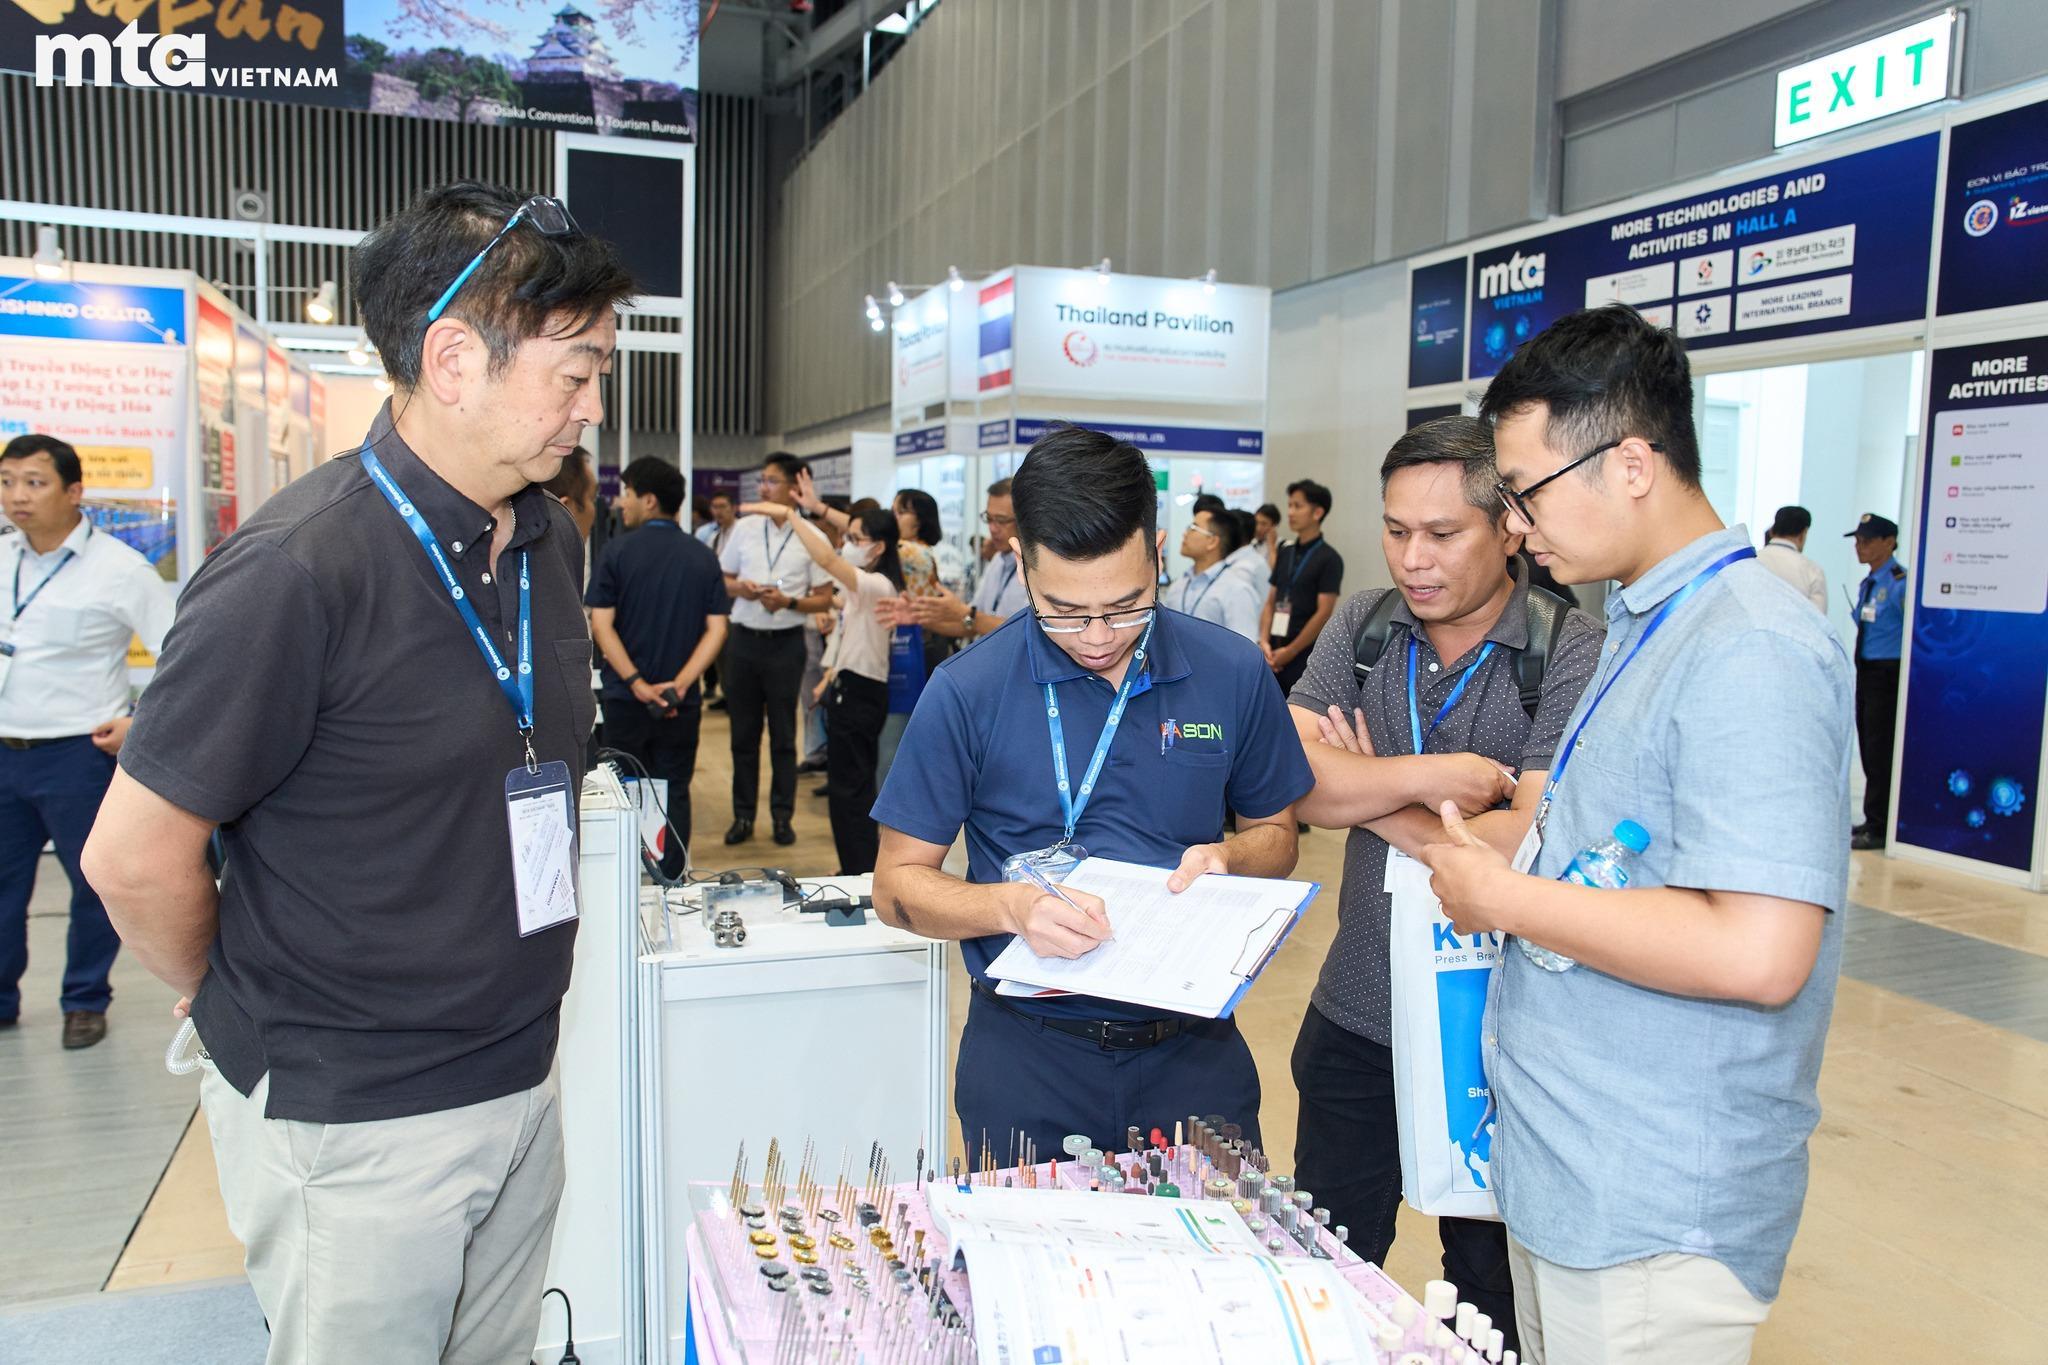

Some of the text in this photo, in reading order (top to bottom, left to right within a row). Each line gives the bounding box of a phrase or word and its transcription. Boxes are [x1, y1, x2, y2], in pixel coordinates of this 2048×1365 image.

[1790, 38, 1934, 125] EXIT
[527, 106, 594, 126] Convention
[595, 117, 604, 127] &
[606, 115, 650, 131] Tourism
[651, 120, 690, 136] Bureau
[1611, 173, 1826, 241] MORE TECHNOLOGIES AND
[1628, 208, 1797, 260] ACTIVITIES IN HALL A
[1479, 250, 1546, 299] mta
[1494, 290, 1544, 310] VIETNAM
[1742, 297, 1844, 319] INTERNATIONAL BRANDS
[1761, 289, 1823, 305] MORE LEADING
[1056, 304, 1233, 334] Thailand Pavilion
[1971, 355, 2028, 378] MORE
[1949, 374, 2048, 400] ACTIVITIES
[1435, 953, 1468, 964] Press
